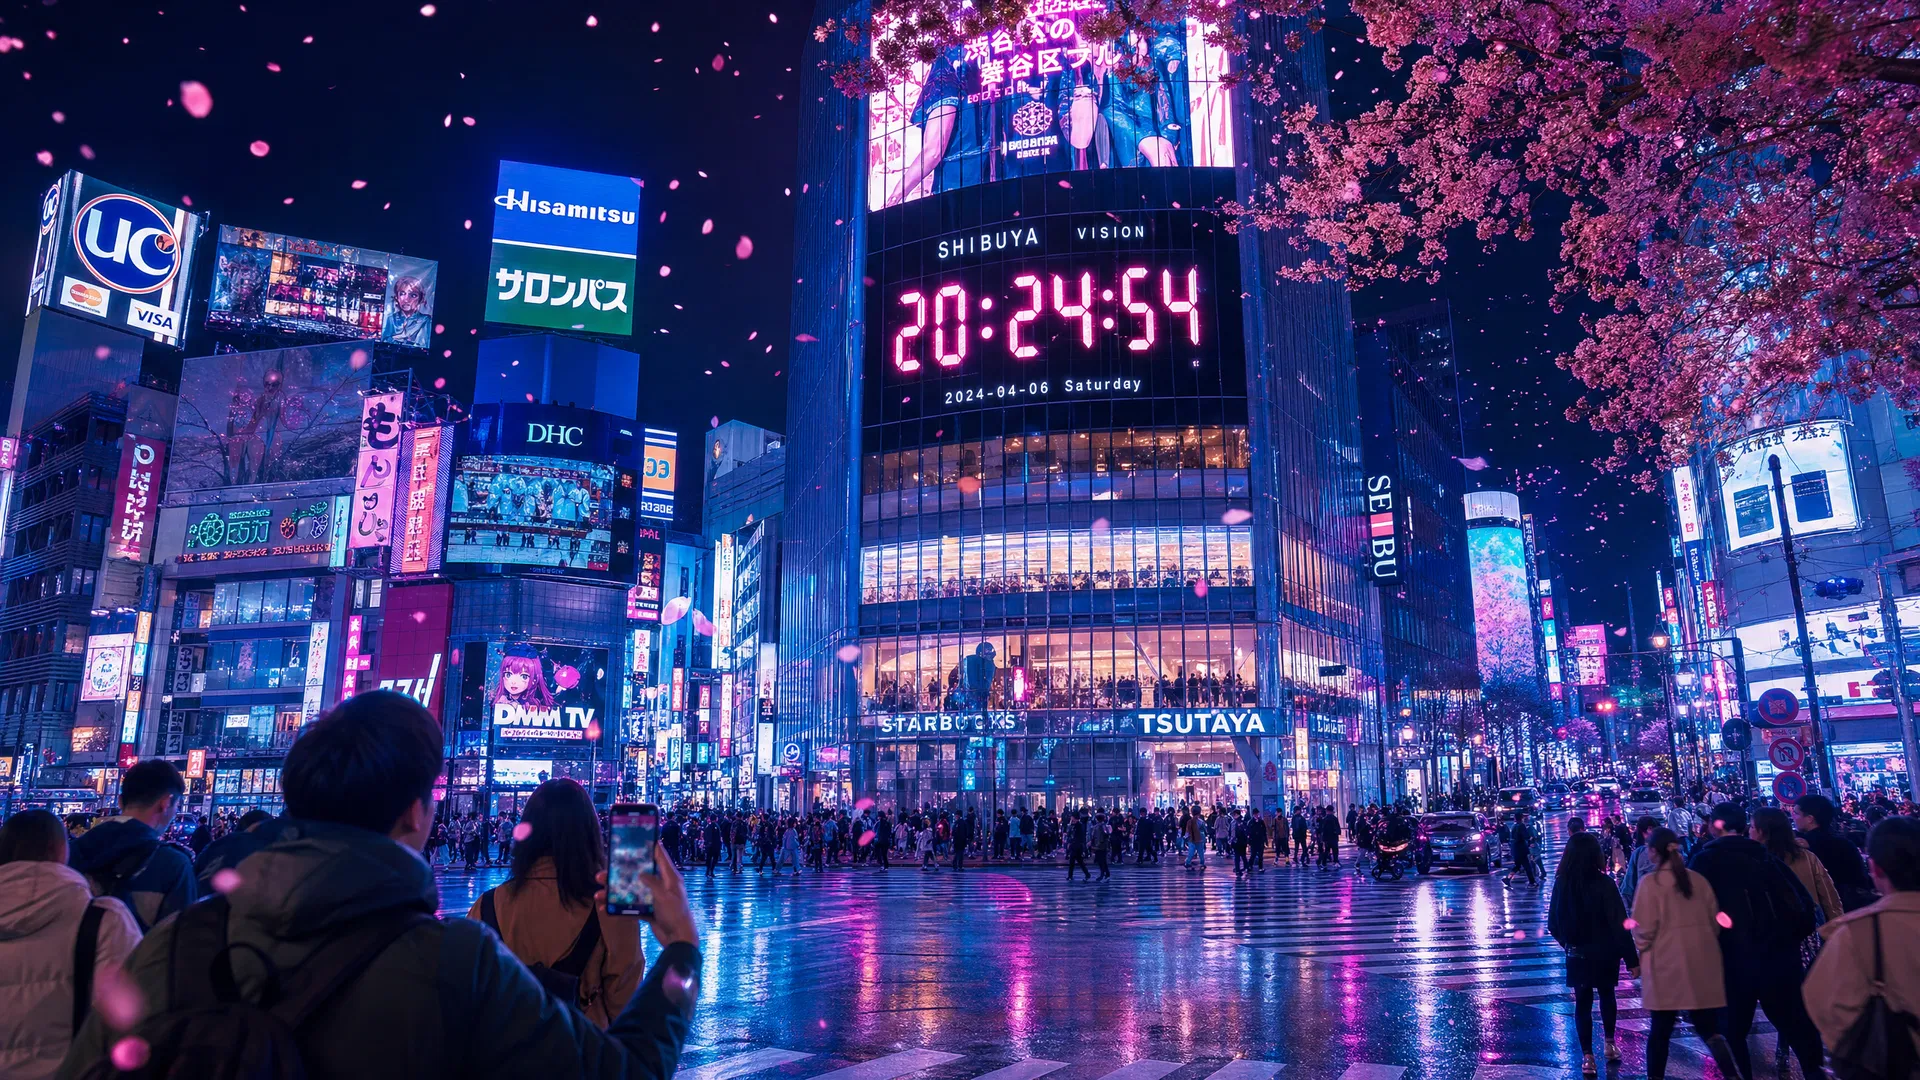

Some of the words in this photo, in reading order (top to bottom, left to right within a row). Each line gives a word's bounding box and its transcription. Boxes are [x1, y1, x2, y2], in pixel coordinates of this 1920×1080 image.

[494, 188, 635, 225] Hisamitsu
[938, 228, 1039, 259] SHIBUYA
[1077, 225, 1145, 240] VISION
[495, 268, 628, 314] サロンパス
[135, 307, 173, 330] VISA
[895, 267, 1199, 372] 20:24:54
[945, 382, 1049, 405] 2024-04-06
[1064, 377, 1142, 393] Saturday
[526, 423, 584, 447] DHC
[1367, 475, 1397, 577] SEIBU
[565, 706, 595, 729] TV
[881, 714, 1016, 733] STARBUCKS
[1138, 713, 1266, 734] TSUTAYA
